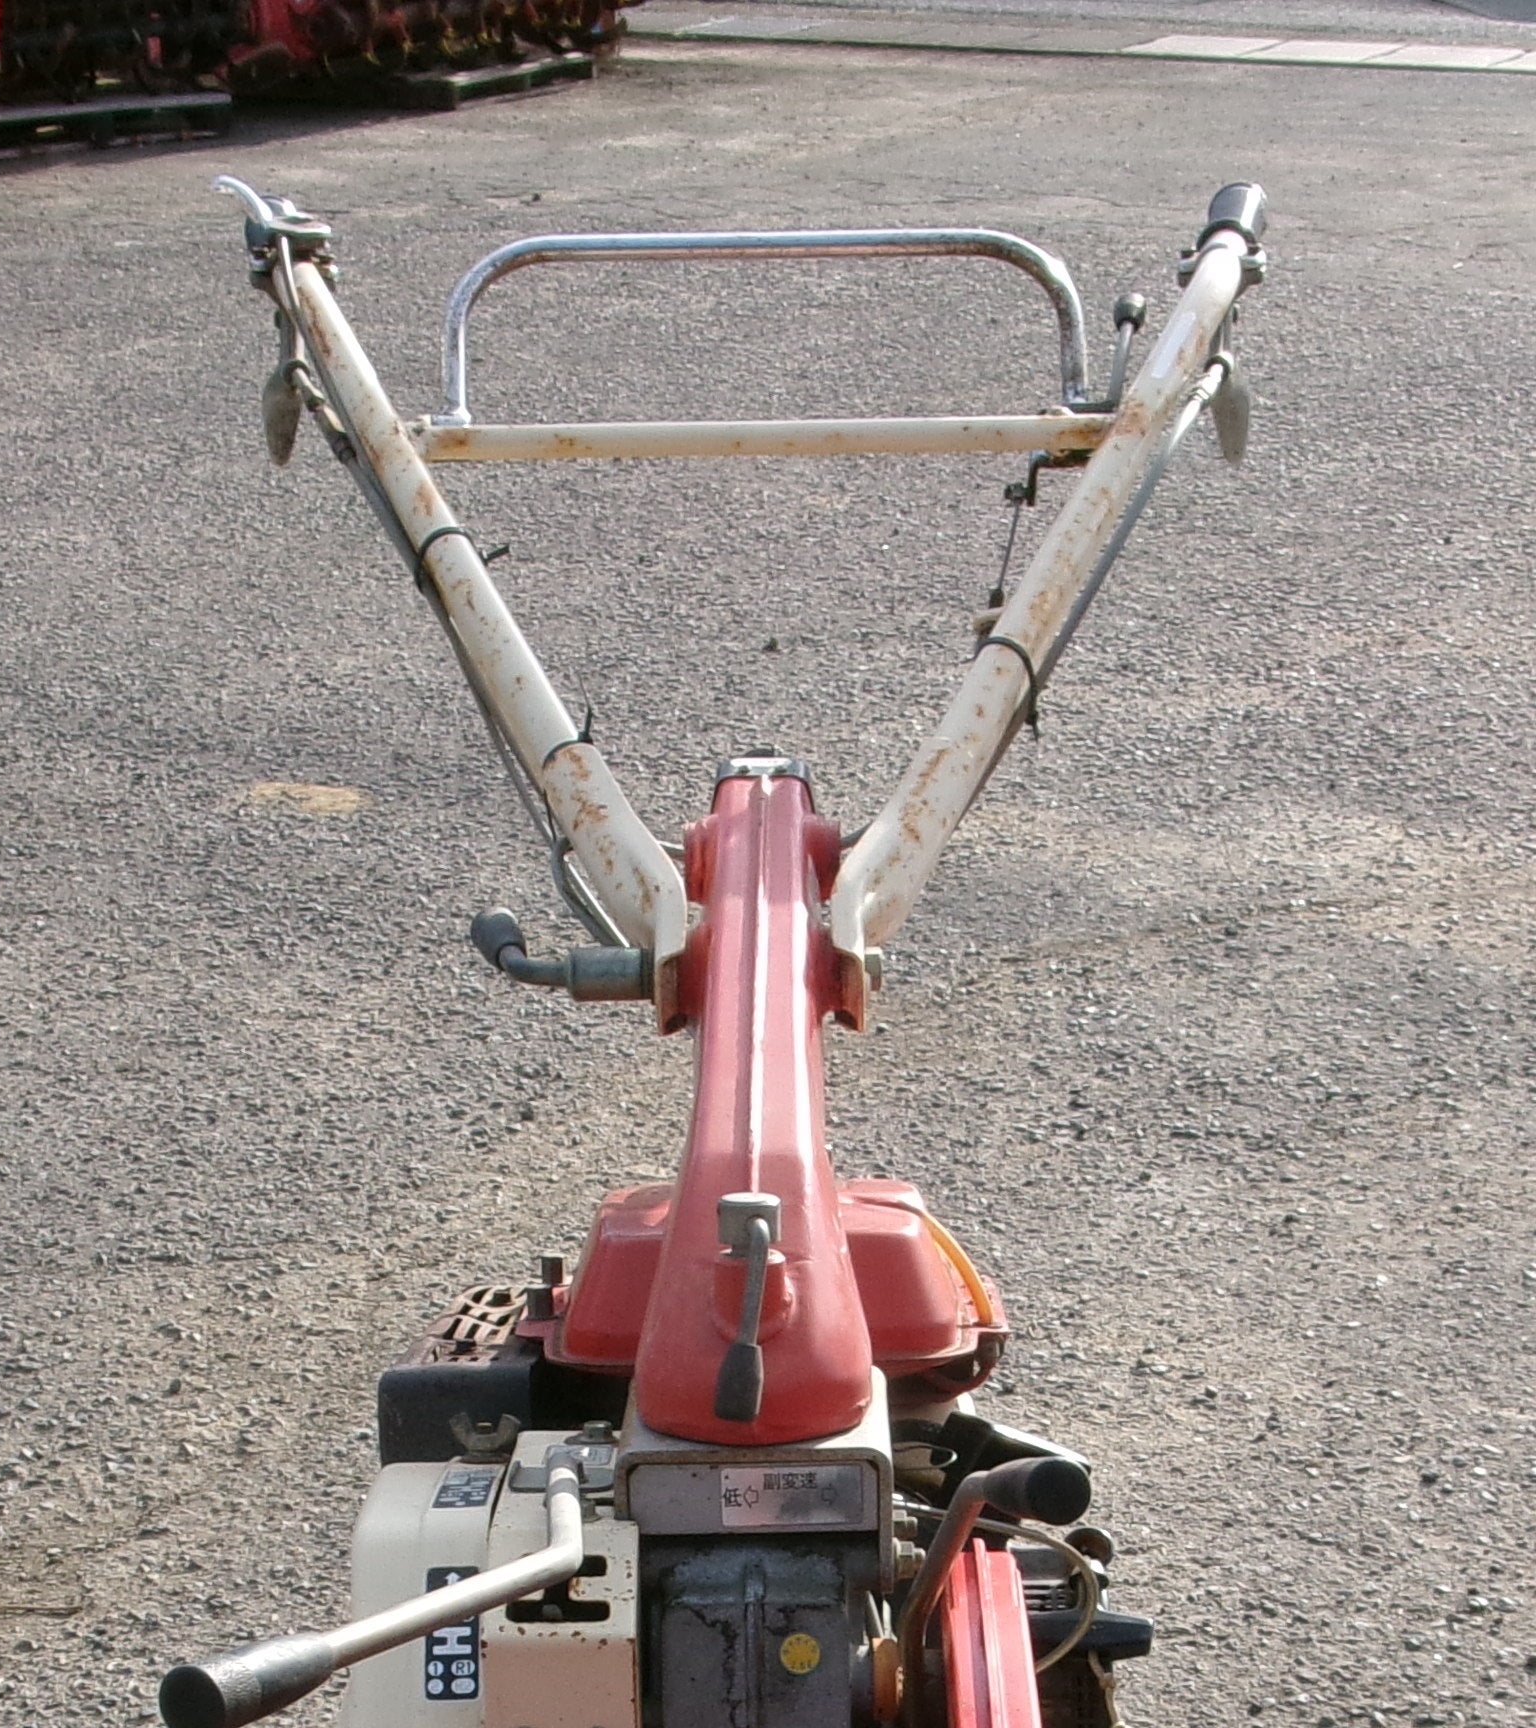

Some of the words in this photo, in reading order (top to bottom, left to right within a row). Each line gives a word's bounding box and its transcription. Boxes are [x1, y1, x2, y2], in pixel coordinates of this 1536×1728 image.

[763, 1472, 818, 1491] 副変速
[722, 1487, 743, 1508] 低
[455, 1661, 472, 1674] R1
